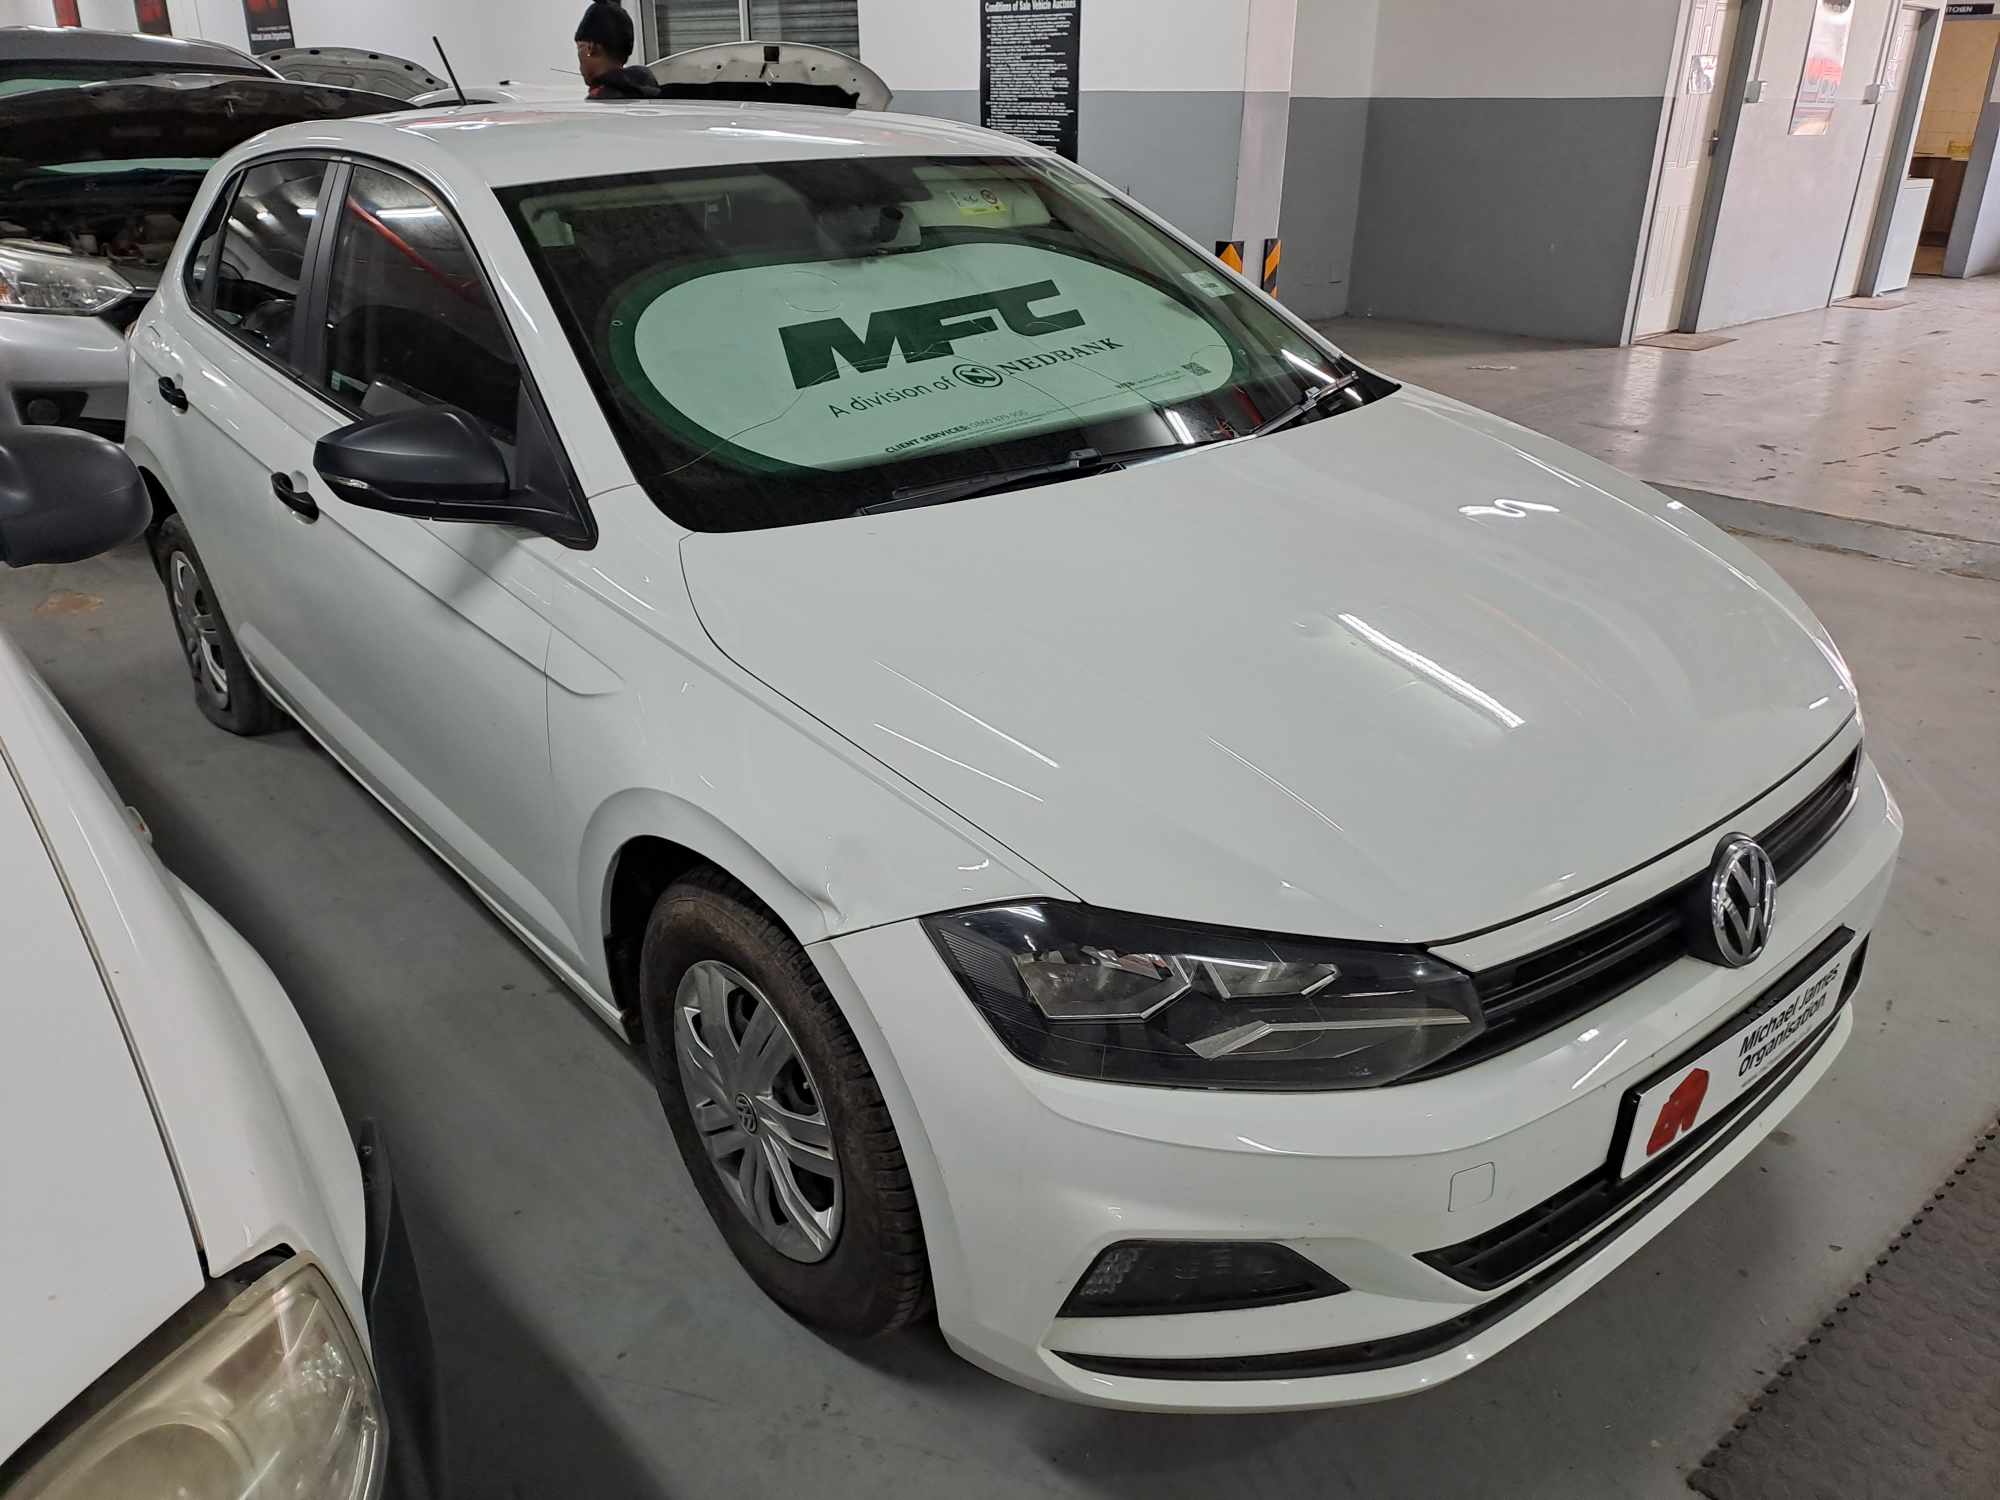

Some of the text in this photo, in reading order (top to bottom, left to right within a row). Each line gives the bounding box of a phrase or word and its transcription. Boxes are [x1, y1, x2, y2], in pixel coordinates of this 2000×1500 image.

[985, 0, 1076, 12] Conditions of Sale Vehicle Auctions
[778, 279, 1086, 390] MFC
[828, 337, 1124, 418] A division of NEDBANK
[885, 439, 920, 453] CLIENT
[1738, 995, 1801, 1057] Michael
[1799, 963, 1840, 1010] James
[1738, 991, 1827, 1077] Organisation
